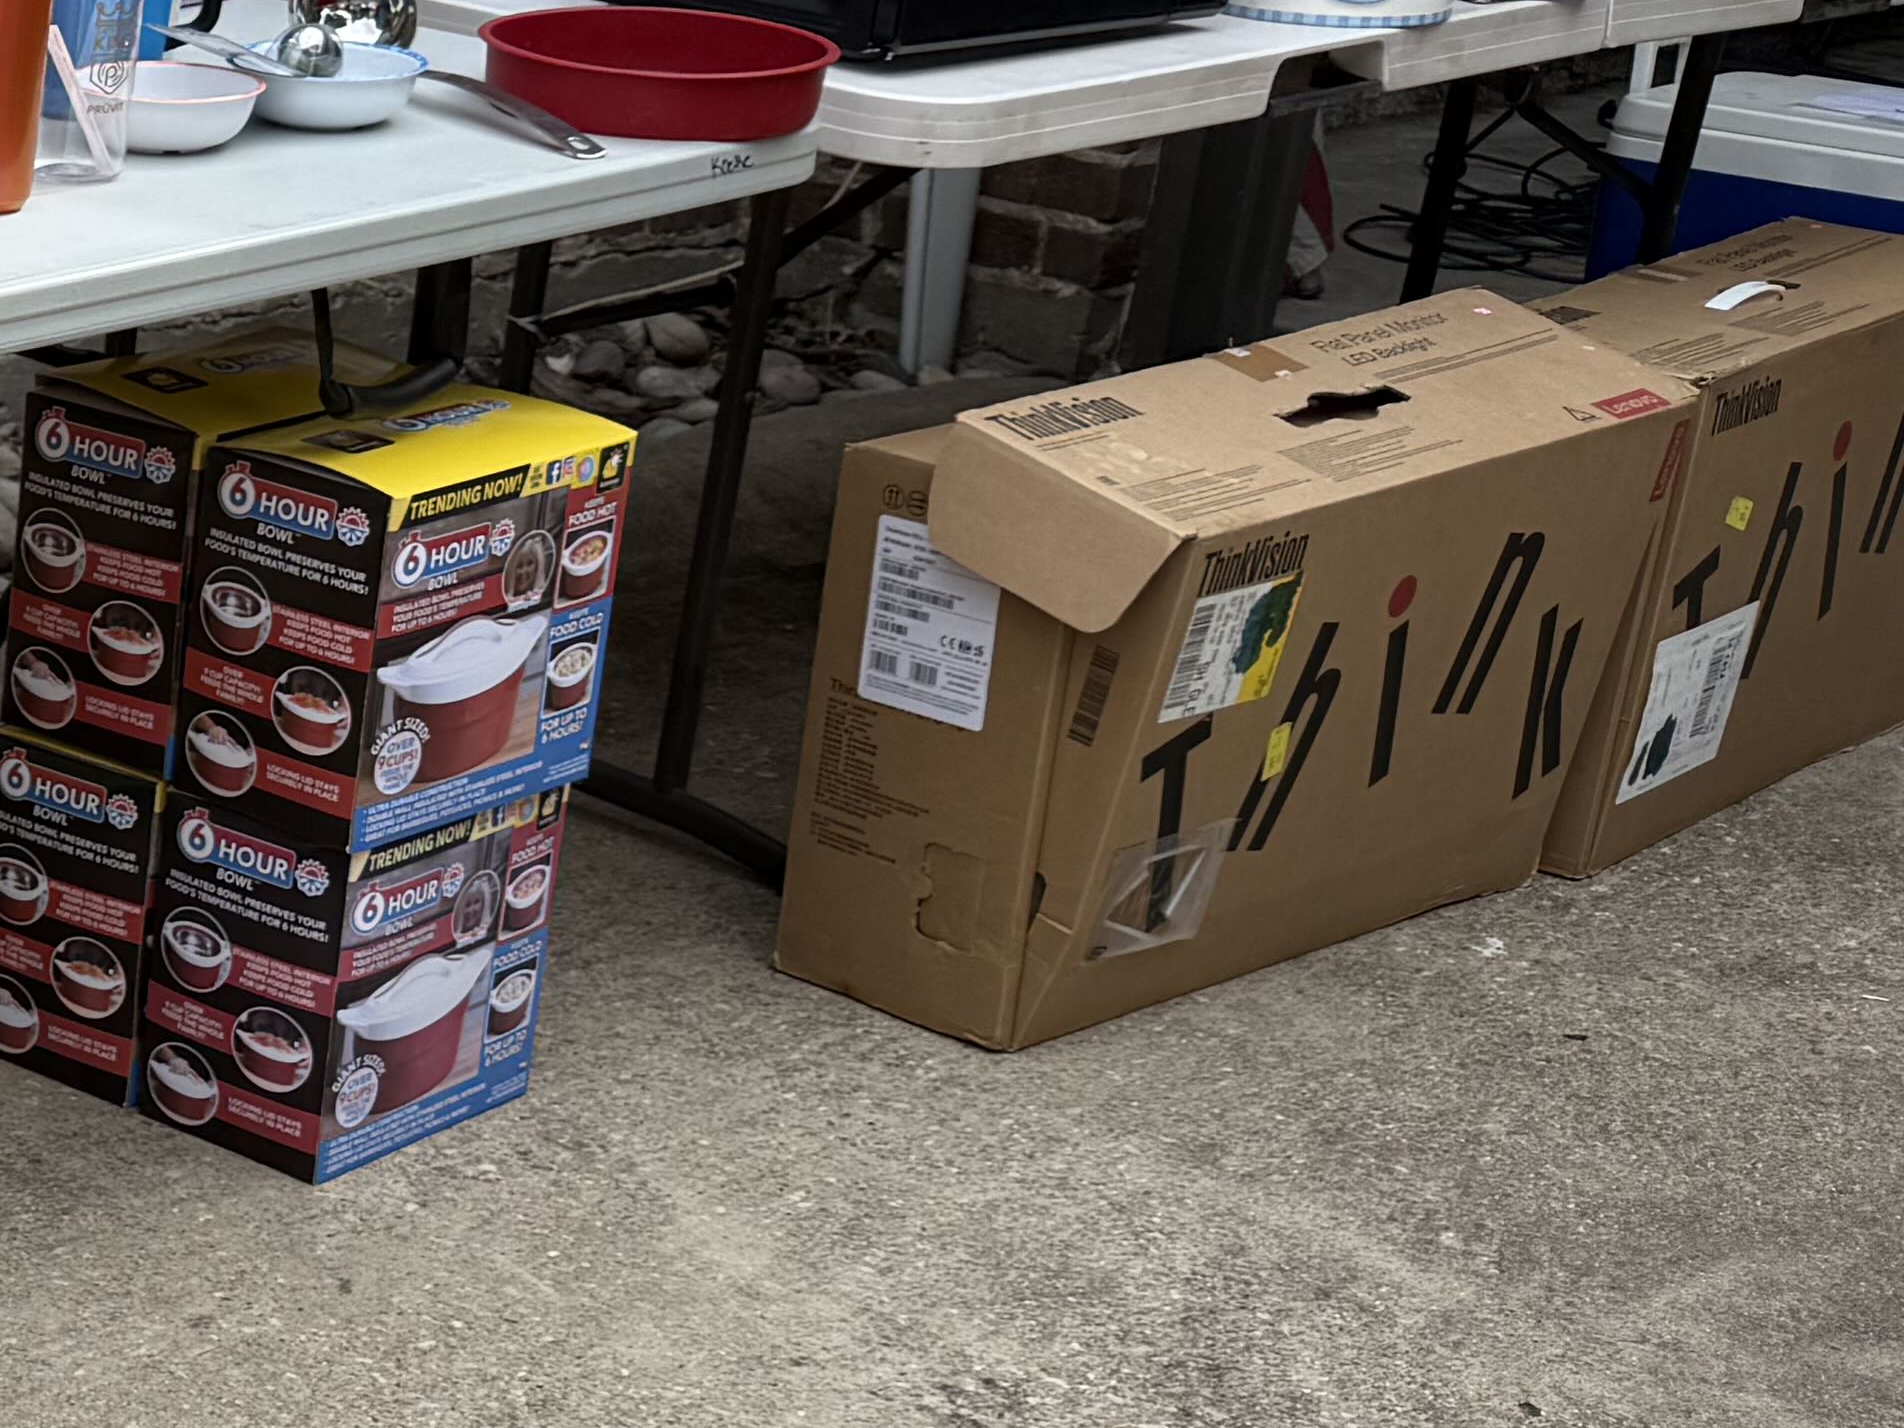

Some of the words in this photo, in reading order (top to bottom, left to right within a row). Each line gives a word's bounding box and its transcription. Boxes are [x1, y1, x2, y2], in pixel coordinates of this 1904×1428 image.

[1341, 325, 1393, 348] Panel
[1390, 312, 1448, 336] Monitor
[1342, 348, 1378, 367] LED
[1371, 335, 1439, 361] Backlight
[982, 396, 1146, 441] ThinkVision
[73, 435, 138, 471] HOUR
[259, 491, 330, 532] HOUR
[410, 484, 482, 520] TRENDING
[483, 472, 525, 501] NOW!
[568, 510, 597, 526] FOOD
[597, 501, 618, 518] HOT
[256, 523, 295, 545] BOWL
[429, 534, 485, 569] HOUR
[209, 527, 257, 551] INSULATED
[257, 540, 284, 560] BOWL
[285, 549, 337, 574] PRESERVES
[337, 565, 367, 582] YOUR
[1197, 530, 1311, 598] ThinkVision
[301, 568, 322, 583] FOR
[550, 621, 578, 638] FOOD
[578, 612, 604, 631] COLD
[370, 719, 403, 756] GIANT
[386, 737, 416, 755] OVER
[34, 776, 101, 815] HOUR
[218, 838, 289, 881] HOUR
[368, 833, 434, 872] TRENDING
[435, 819, 473, 847] NOW!
[215, 868, 254, 892] BOWL
[387, 880, 439, 914] HOUR
